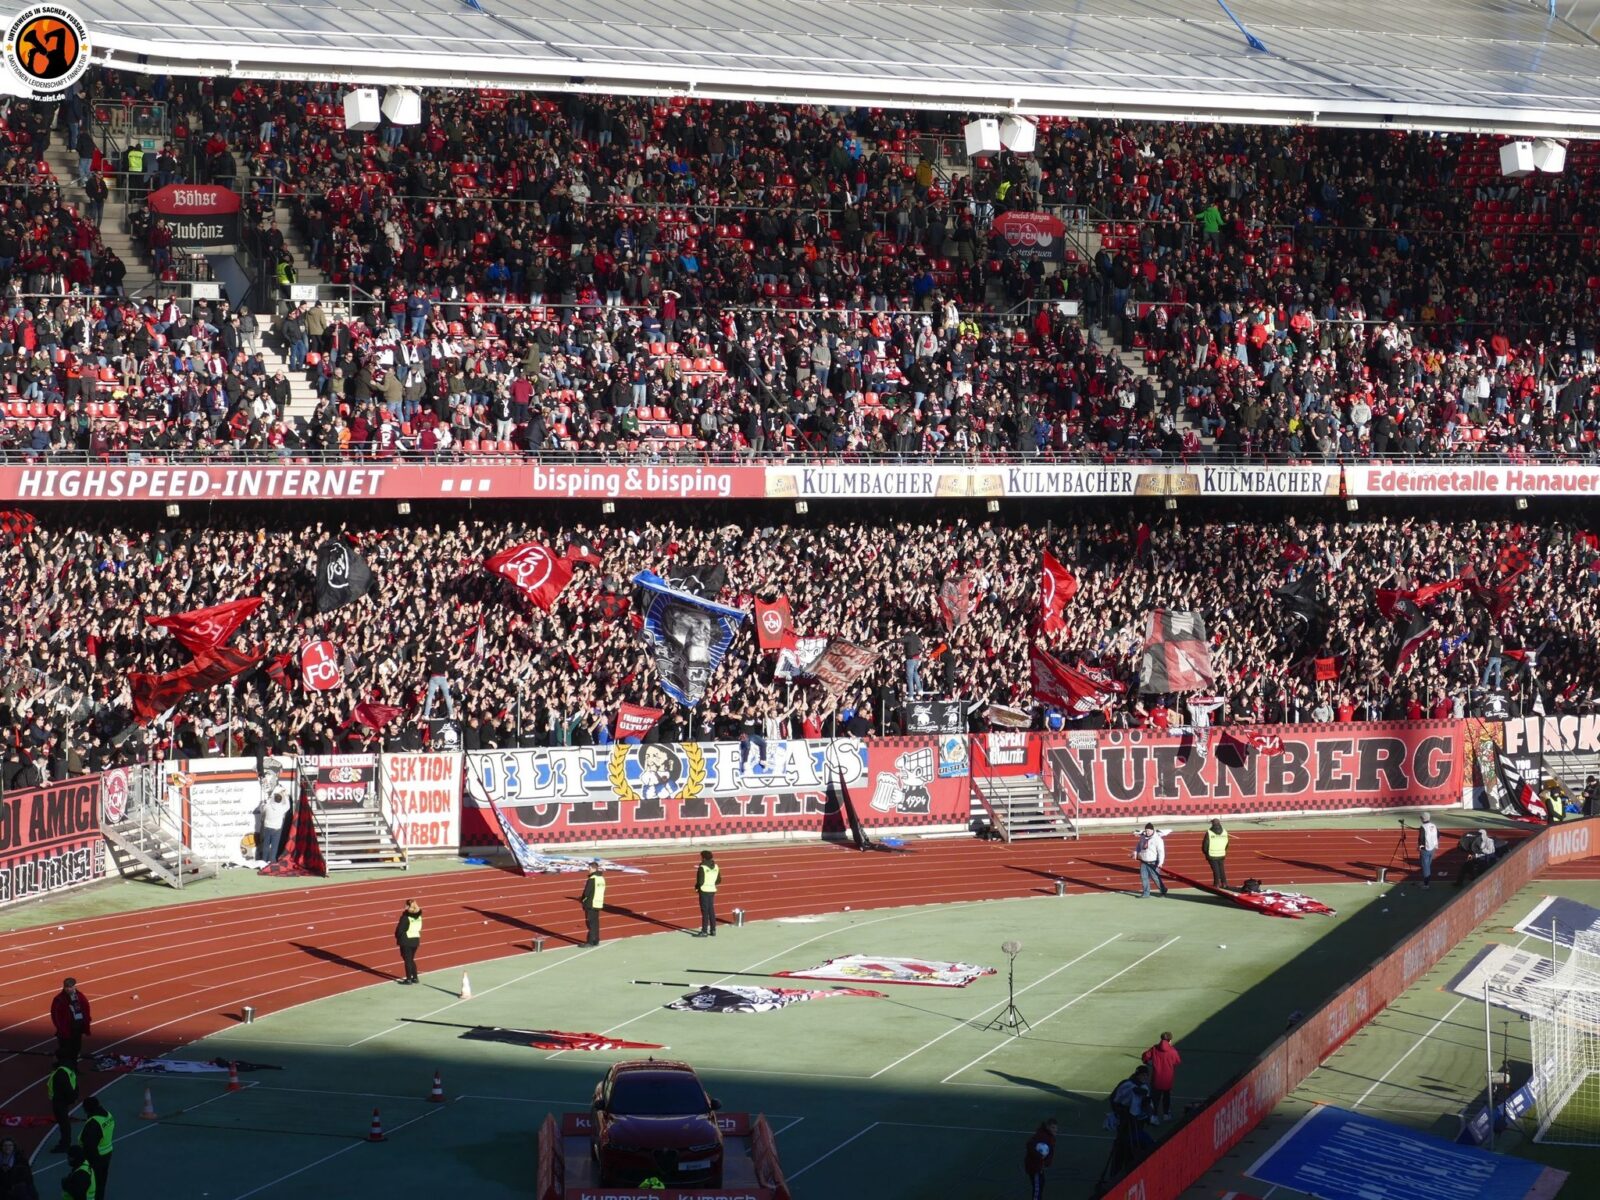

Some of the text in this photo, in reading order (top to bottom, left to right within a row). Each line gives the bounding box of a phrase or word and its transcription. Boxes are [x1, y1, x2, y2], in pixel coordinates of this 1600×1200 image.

[172, 189, 217, 208] Böhse
[1021, 232, 1036, 240] FCN
[18, 470, 384, 496] HIGHSPEED-INTERNET
[533, 467, 732, 496] bisping & bisping
[802, 468, 934, 494] KULMBACHER
[1008, 468, 1132, 493] KULMBACHER
[1203, 468, 1322, 492] KULMBACHER
[1506, 470, 1600, 492] Hanauer
[315, 644, 329, 662] 1.
[306, 659, 338, 685] FCN
[390, 756, 452, 783] SEKTION
[1046, 730, 1456, 804] NÜRNBERG
[28, 784, 100, 842] AMICI
[390, 789, 451, 815] STADION
